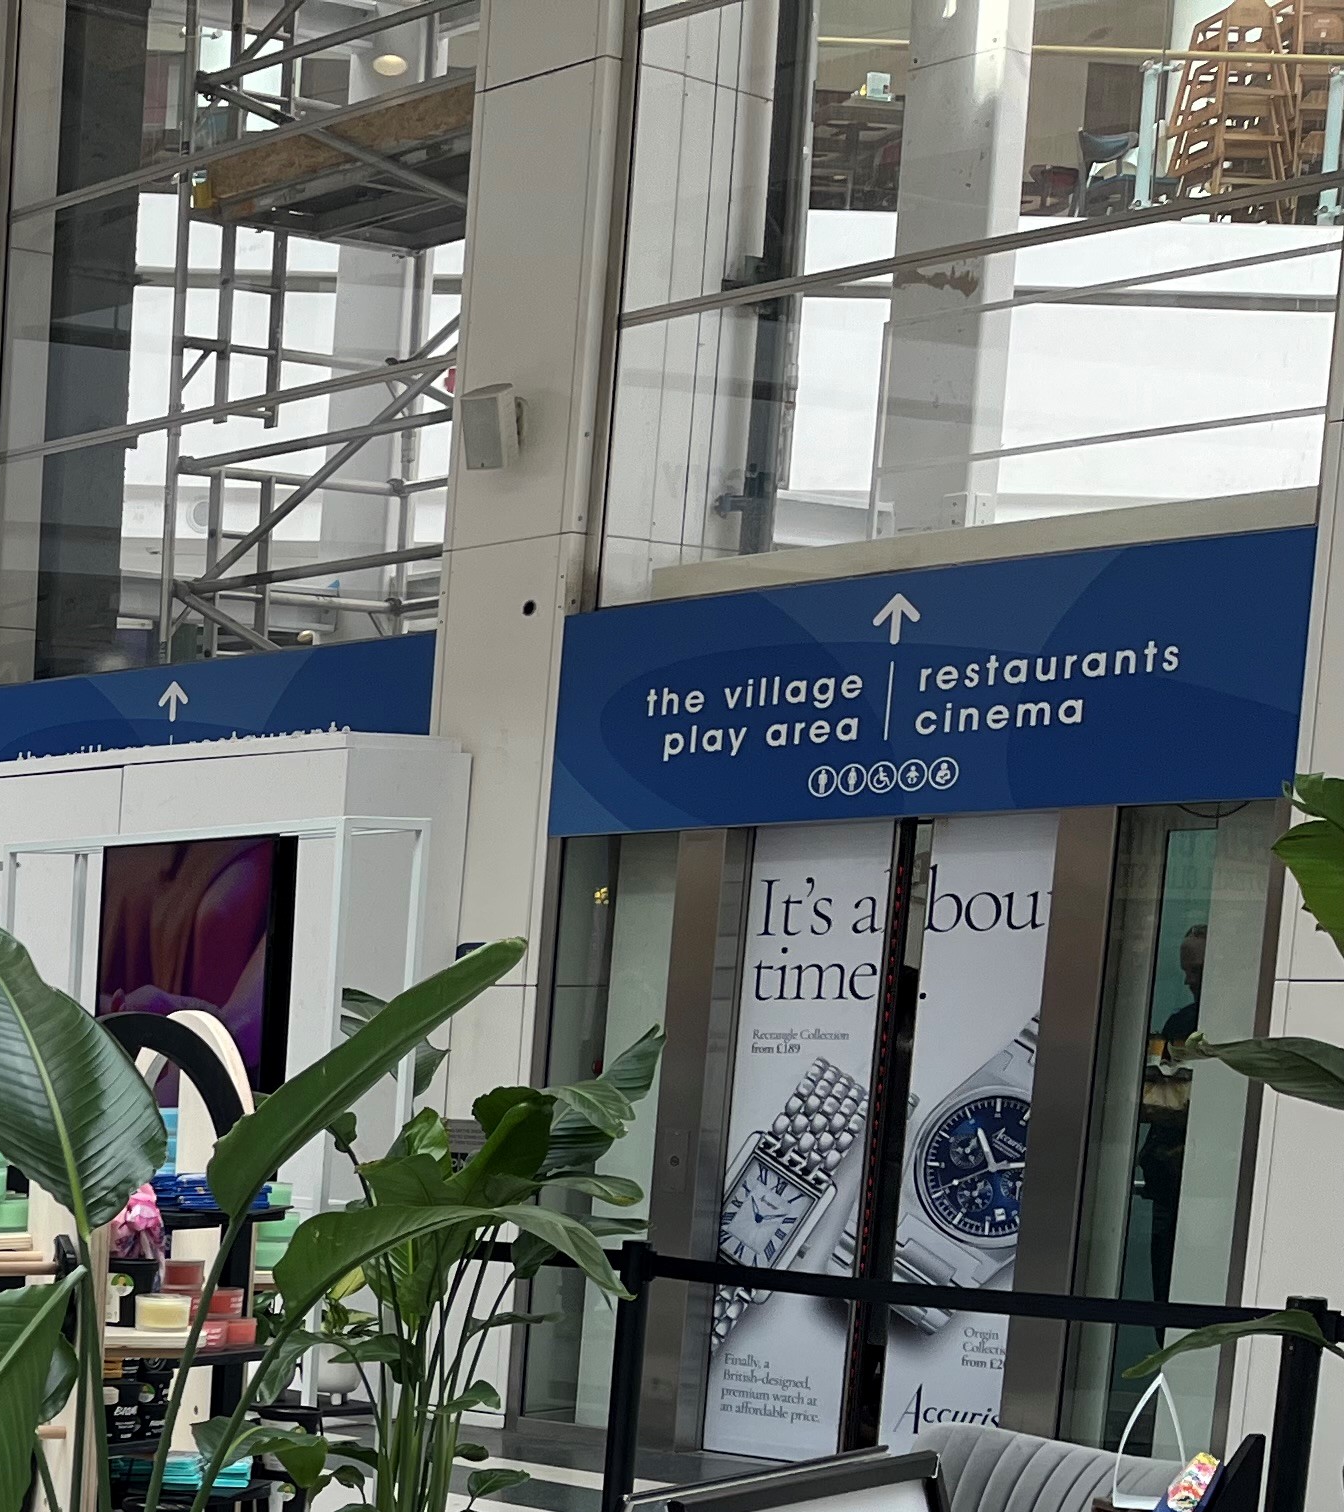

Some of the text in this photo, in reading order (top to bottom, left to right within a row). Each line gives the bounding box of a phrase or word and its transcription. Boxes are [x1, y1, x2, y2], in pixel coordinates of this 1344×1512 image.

[919, 640, 1181, 692] restaurants
[647, 672, 864, 717] the village
[915, 697, 1084, 735] cinema
[662, 716, 859, 761] play area
[756, 877, 833, 936] It's
[753, 1028, 850, 1042] Rectangle Collection
[751, 1042, 801, 1054] from £189
[963, 1327, 999, 1342] Origin
[724, 1352, 770, 1369] Finally, a
[961, 1355, 1004, 1370] from £2
[721, 1387, 818, 1406] premium watch at
[720, 1403, 733, 1412] an
[735, 1401, 788, 1419] affordable
